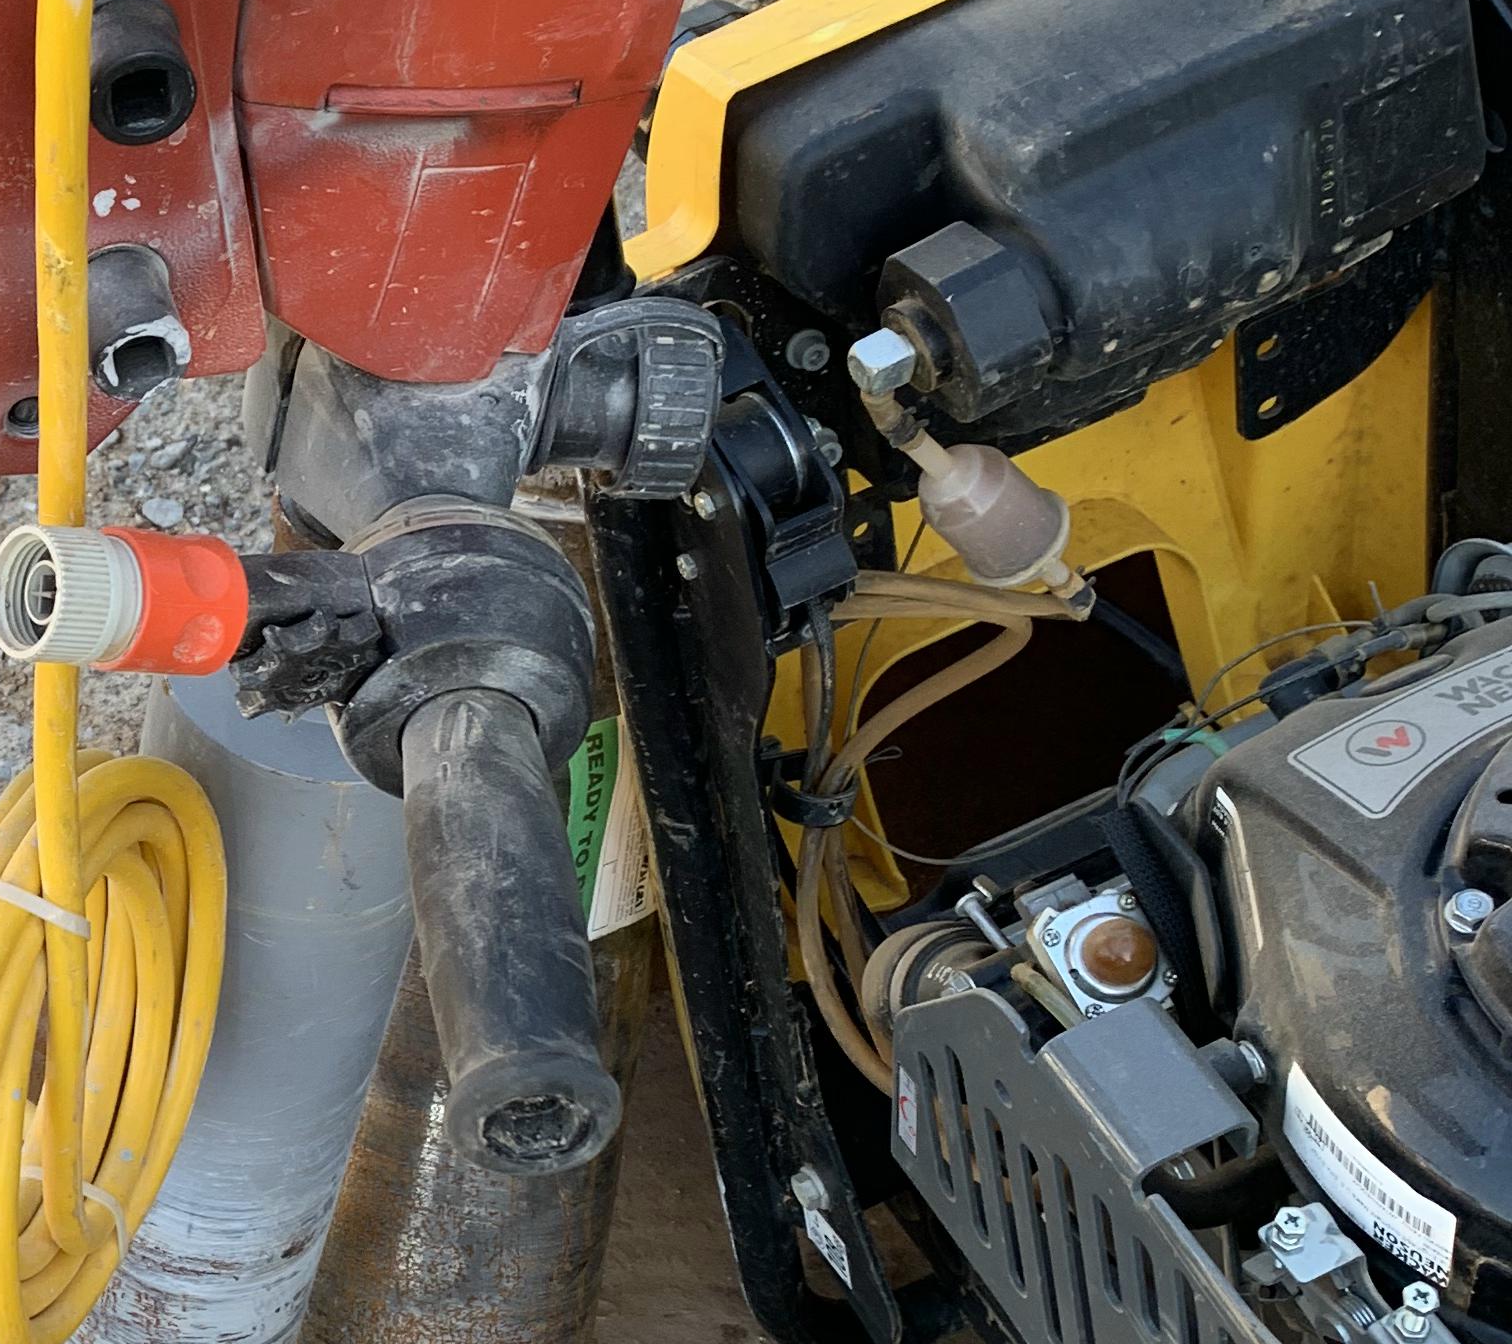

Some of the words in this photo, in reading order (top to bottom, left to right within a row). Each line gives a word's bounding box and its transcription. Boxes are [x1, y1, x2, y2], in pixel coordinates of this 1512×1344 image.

[1433, 664, 1512, 701] WAC
[1457, 682, 1512, 716] NE
[583, 732, 605, 823] READY
[575, 830, 594, 869] TO
[1373, 1219, 1451, 1277] NEUSON
